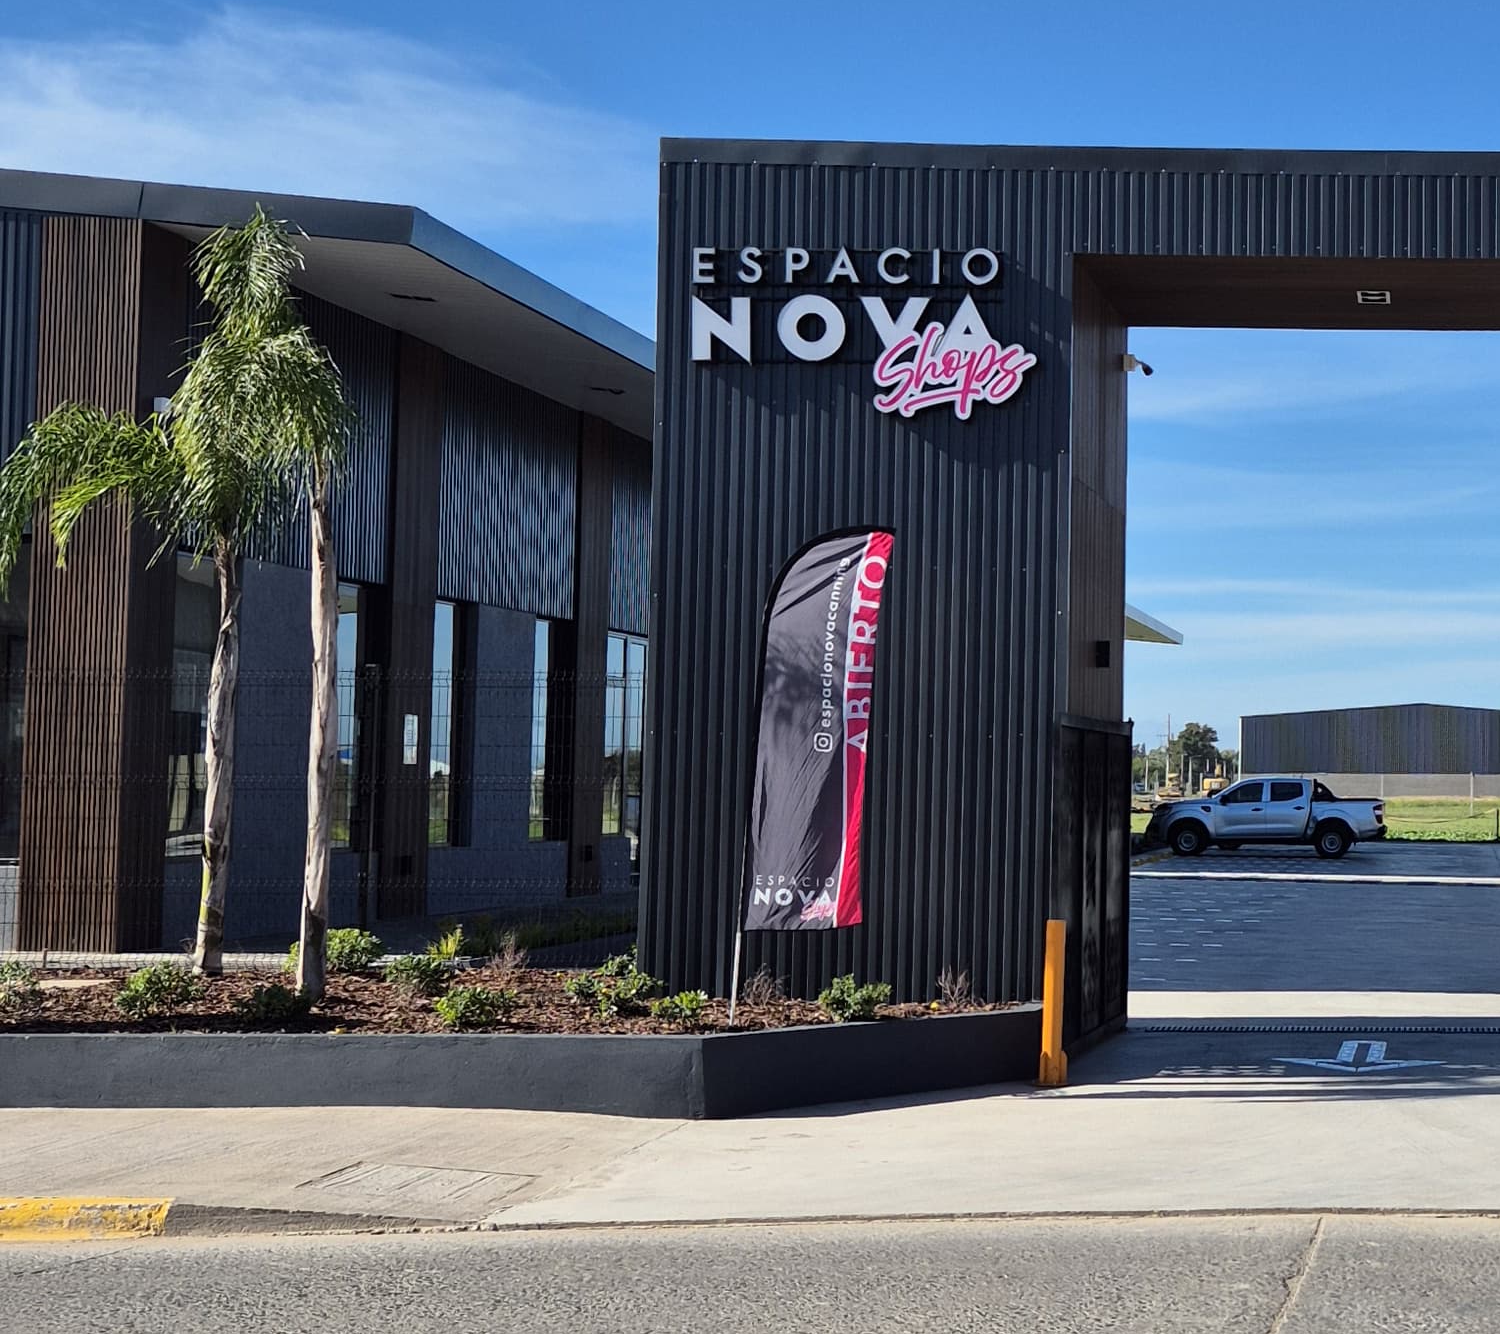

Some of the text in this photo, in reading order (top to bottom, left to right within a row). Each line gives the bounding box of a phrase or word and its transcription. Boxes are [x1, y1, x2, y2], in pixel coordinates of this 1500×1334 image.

[692, 246, 999, 285] ESPACIO
[691, 293, 998, 364] NOVA
[874, 322, 1036, 419] Shops
[820, 556, 851, 729] espacionovacanning
[846, 555, 889, 753] ABIERTO
[753, 888, 832, 906] NOVA
[755, 874, 835, 888] ESPACIO
